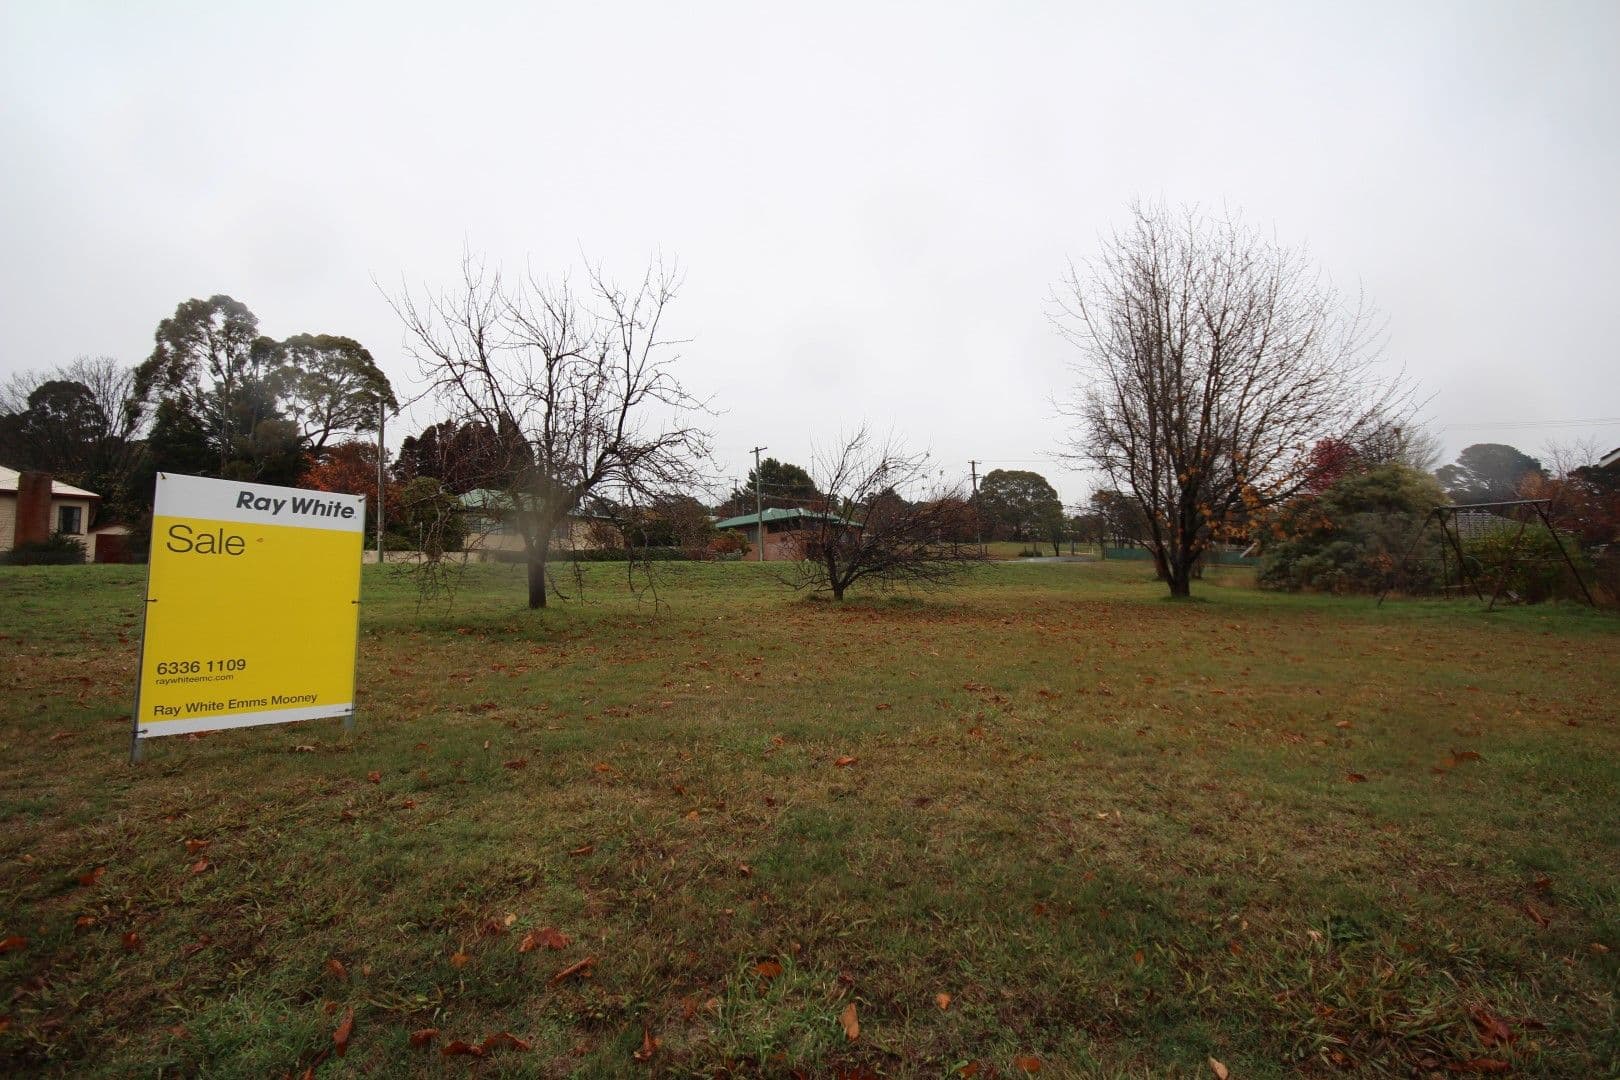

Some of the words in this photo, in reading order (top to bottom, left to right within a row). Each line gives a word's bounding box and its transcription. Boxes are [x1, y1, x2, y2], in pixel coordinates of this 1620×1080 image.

[236, 491, 287, 516] Ray
[166, 524, 245, 556] Sale
[156, 660, 200, 675] 6336
[206, 658, 246, 672] 1109
[155, 674, 234, 685] raywhiteemc.com
[153, 704, 181, 716] Ray
[185, 701, 224, 713] White
[228, 697, 267, 708] Emms
[271, 693, 318, 705] Mooney
